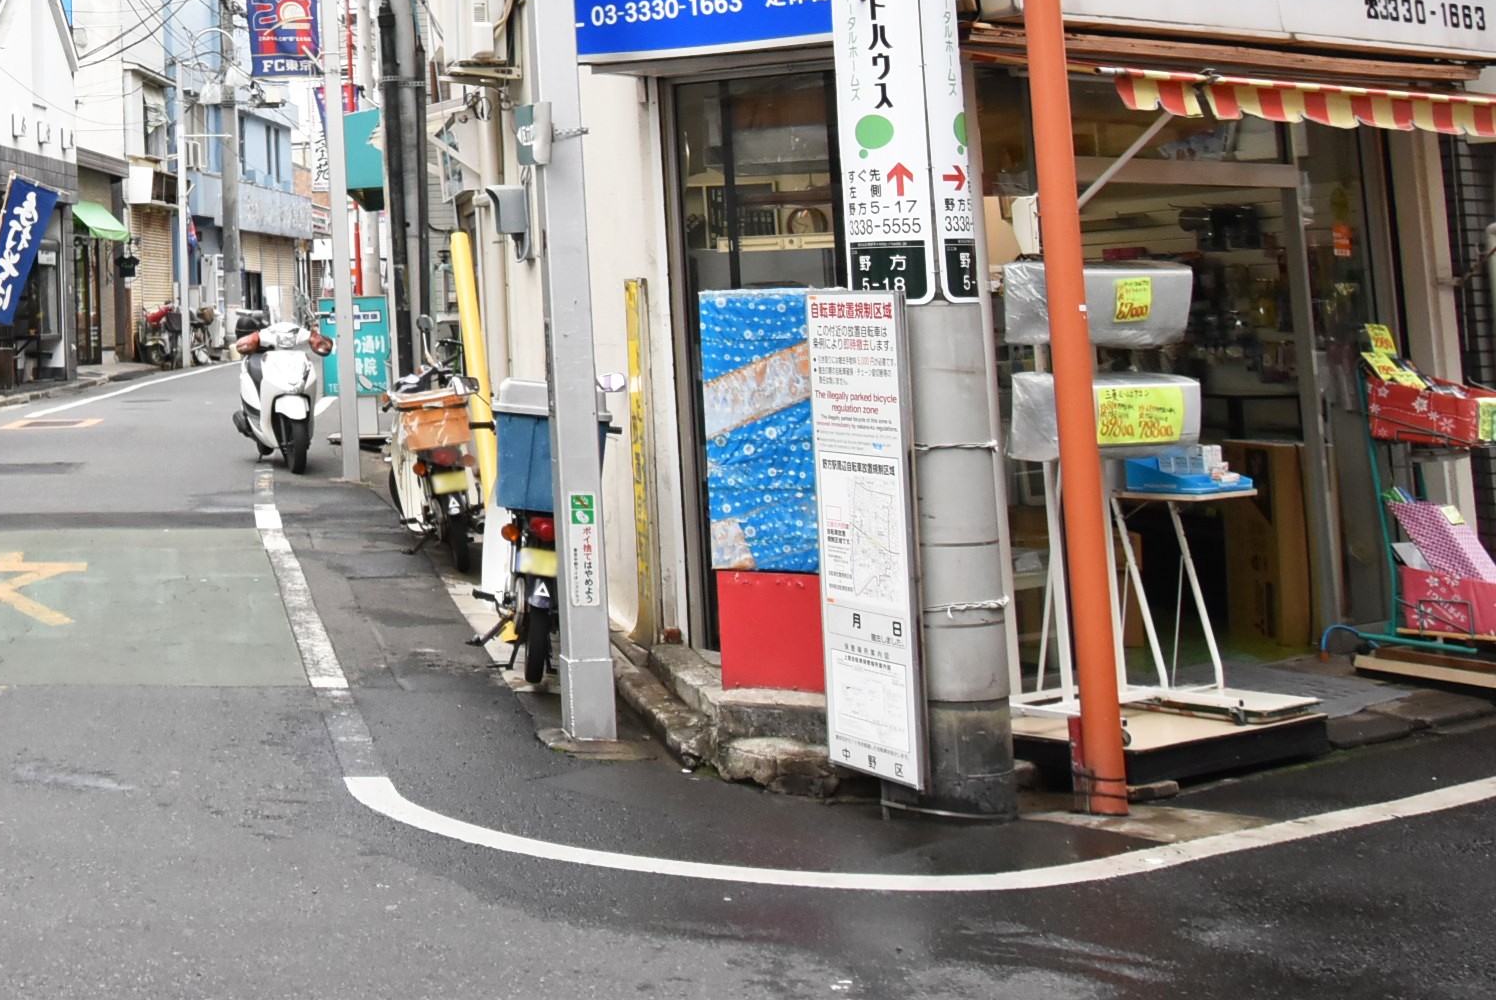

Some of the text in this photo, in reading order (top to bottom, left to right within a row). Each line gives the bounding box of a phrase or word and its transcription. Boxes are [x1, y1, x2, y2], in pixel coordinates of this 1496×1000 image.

[848, 168, 882, 184] すぐ先
[849, 184, 882, 199] 左側
[848, 199, 919, 217] 野方5-17
[849, 217, 923, 236] 3338-5555
[859, 254, 907, 273] 野方
[861, 276, 907, 292] 5-18
[810, 301, 893, 319] 自転車放置規制区域
[816, 324, 888, 338] この付近の放置自転車は
[815, 390, 898, 405] The illegally parked bicycle
[831, 404, 879, 415] regulation zone
[582, 526, 594, 604] ポイ捨てはやめよう
[852, 612, 903, 638] 月 日
[841, 747, 904, 778] 中野区
